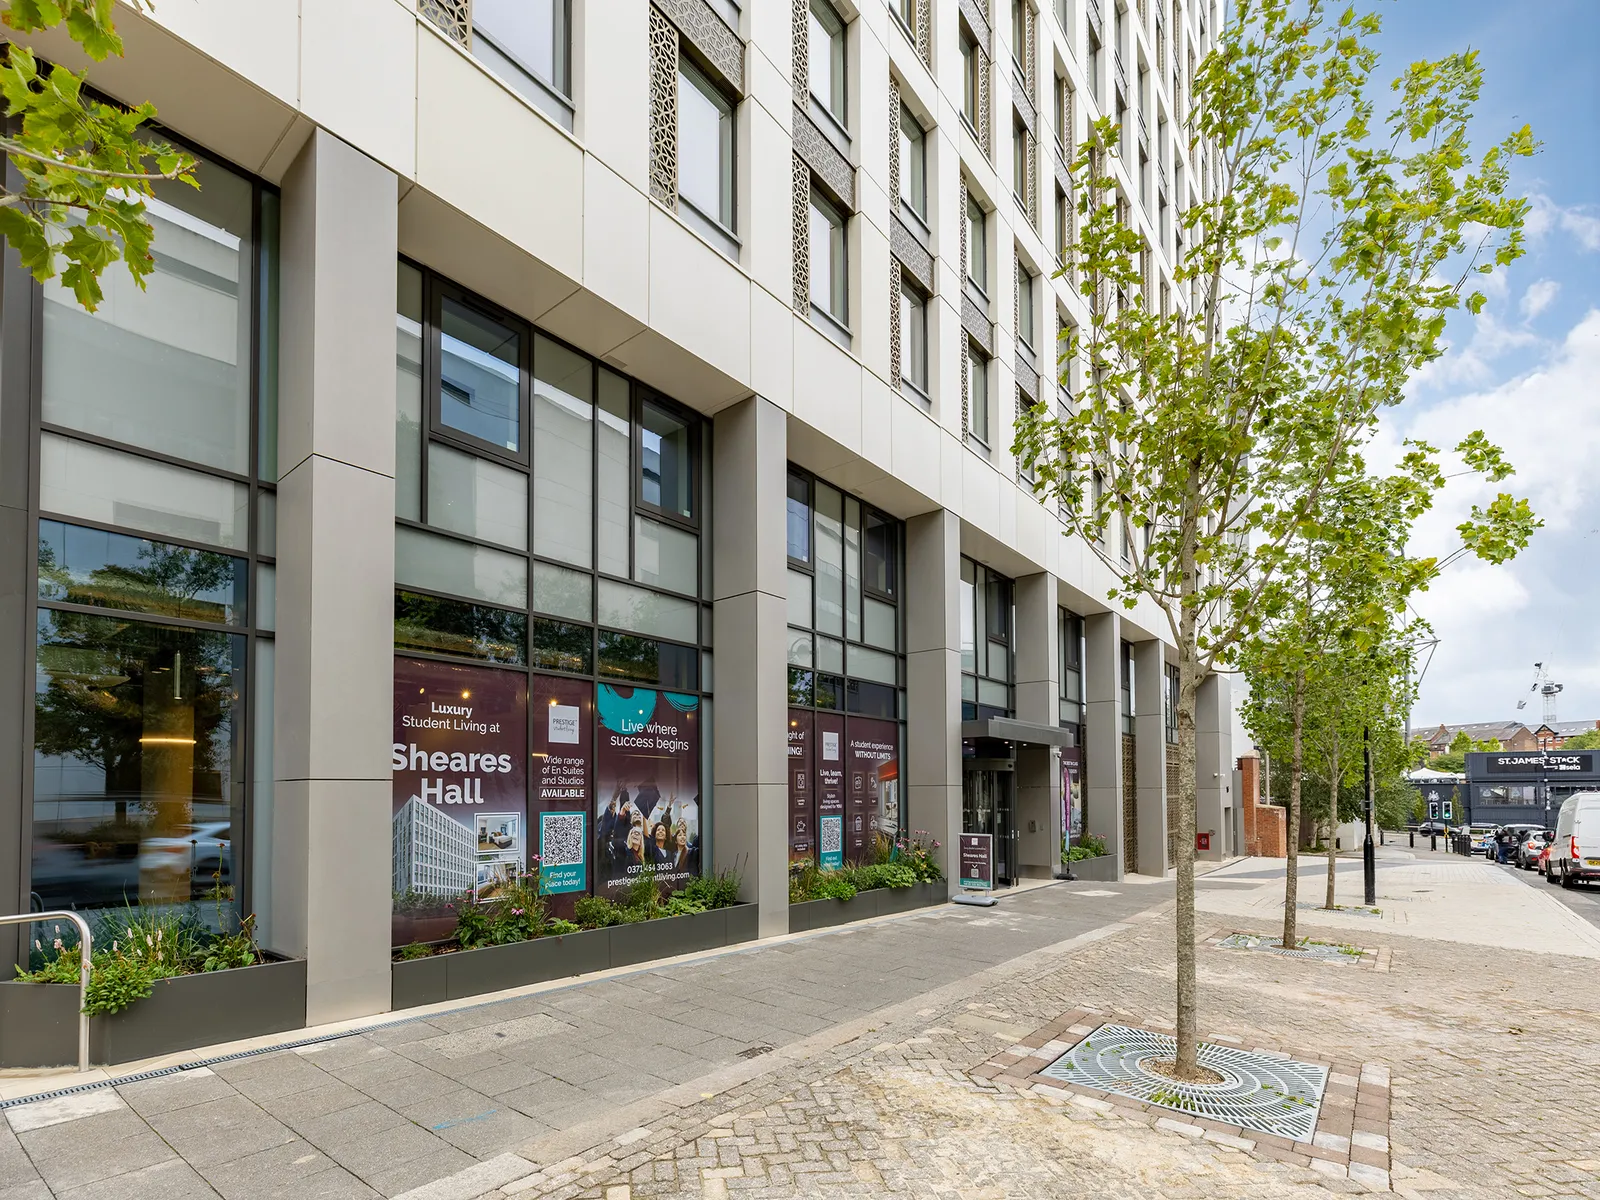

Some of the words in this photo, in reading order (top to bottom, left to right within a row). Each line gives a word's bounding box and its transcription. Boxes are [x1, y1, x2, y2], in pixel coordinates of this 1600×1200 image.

[431, 702, 472, 718] Luxury
[402, 715, 451, 730] Student
[453, 719, 487, 735] Living
[489, 722, 500, 733] at
[552, 718, 575, 726] PRESTIGE
[621, 719, 644, 733] Live
[646, 722, 678, 736] where
[610, 735, 654, 748] success
[656, 736, 689, 753] begins
[850, 740, 855, 748] A
[854, 740, 871, 748] student
[392, 743, 512, 773] Sheares
[854, 750, 877, 759] WITHOUT
[877, 751, 891, 760] LIMITS
[1549, 756, 1581, 764] STACK
[542, 755, 562, 765] Wide
[563, 757, 585, 767] range
[541, 766, 550, 775] of
[551, 766, 561, 775] En
[562, 766, 585, 776] Suites
[541, 777, 556, 786] and
[557, 776, 585, 786] Studios
[421, 778, 484, 804] Hall
[541, 788, 585, 798] AVAILABLE
[626, 864, 643, 874] 0371
[563, 871, 577, 879] your
[562, 878, 581, 887] today!
